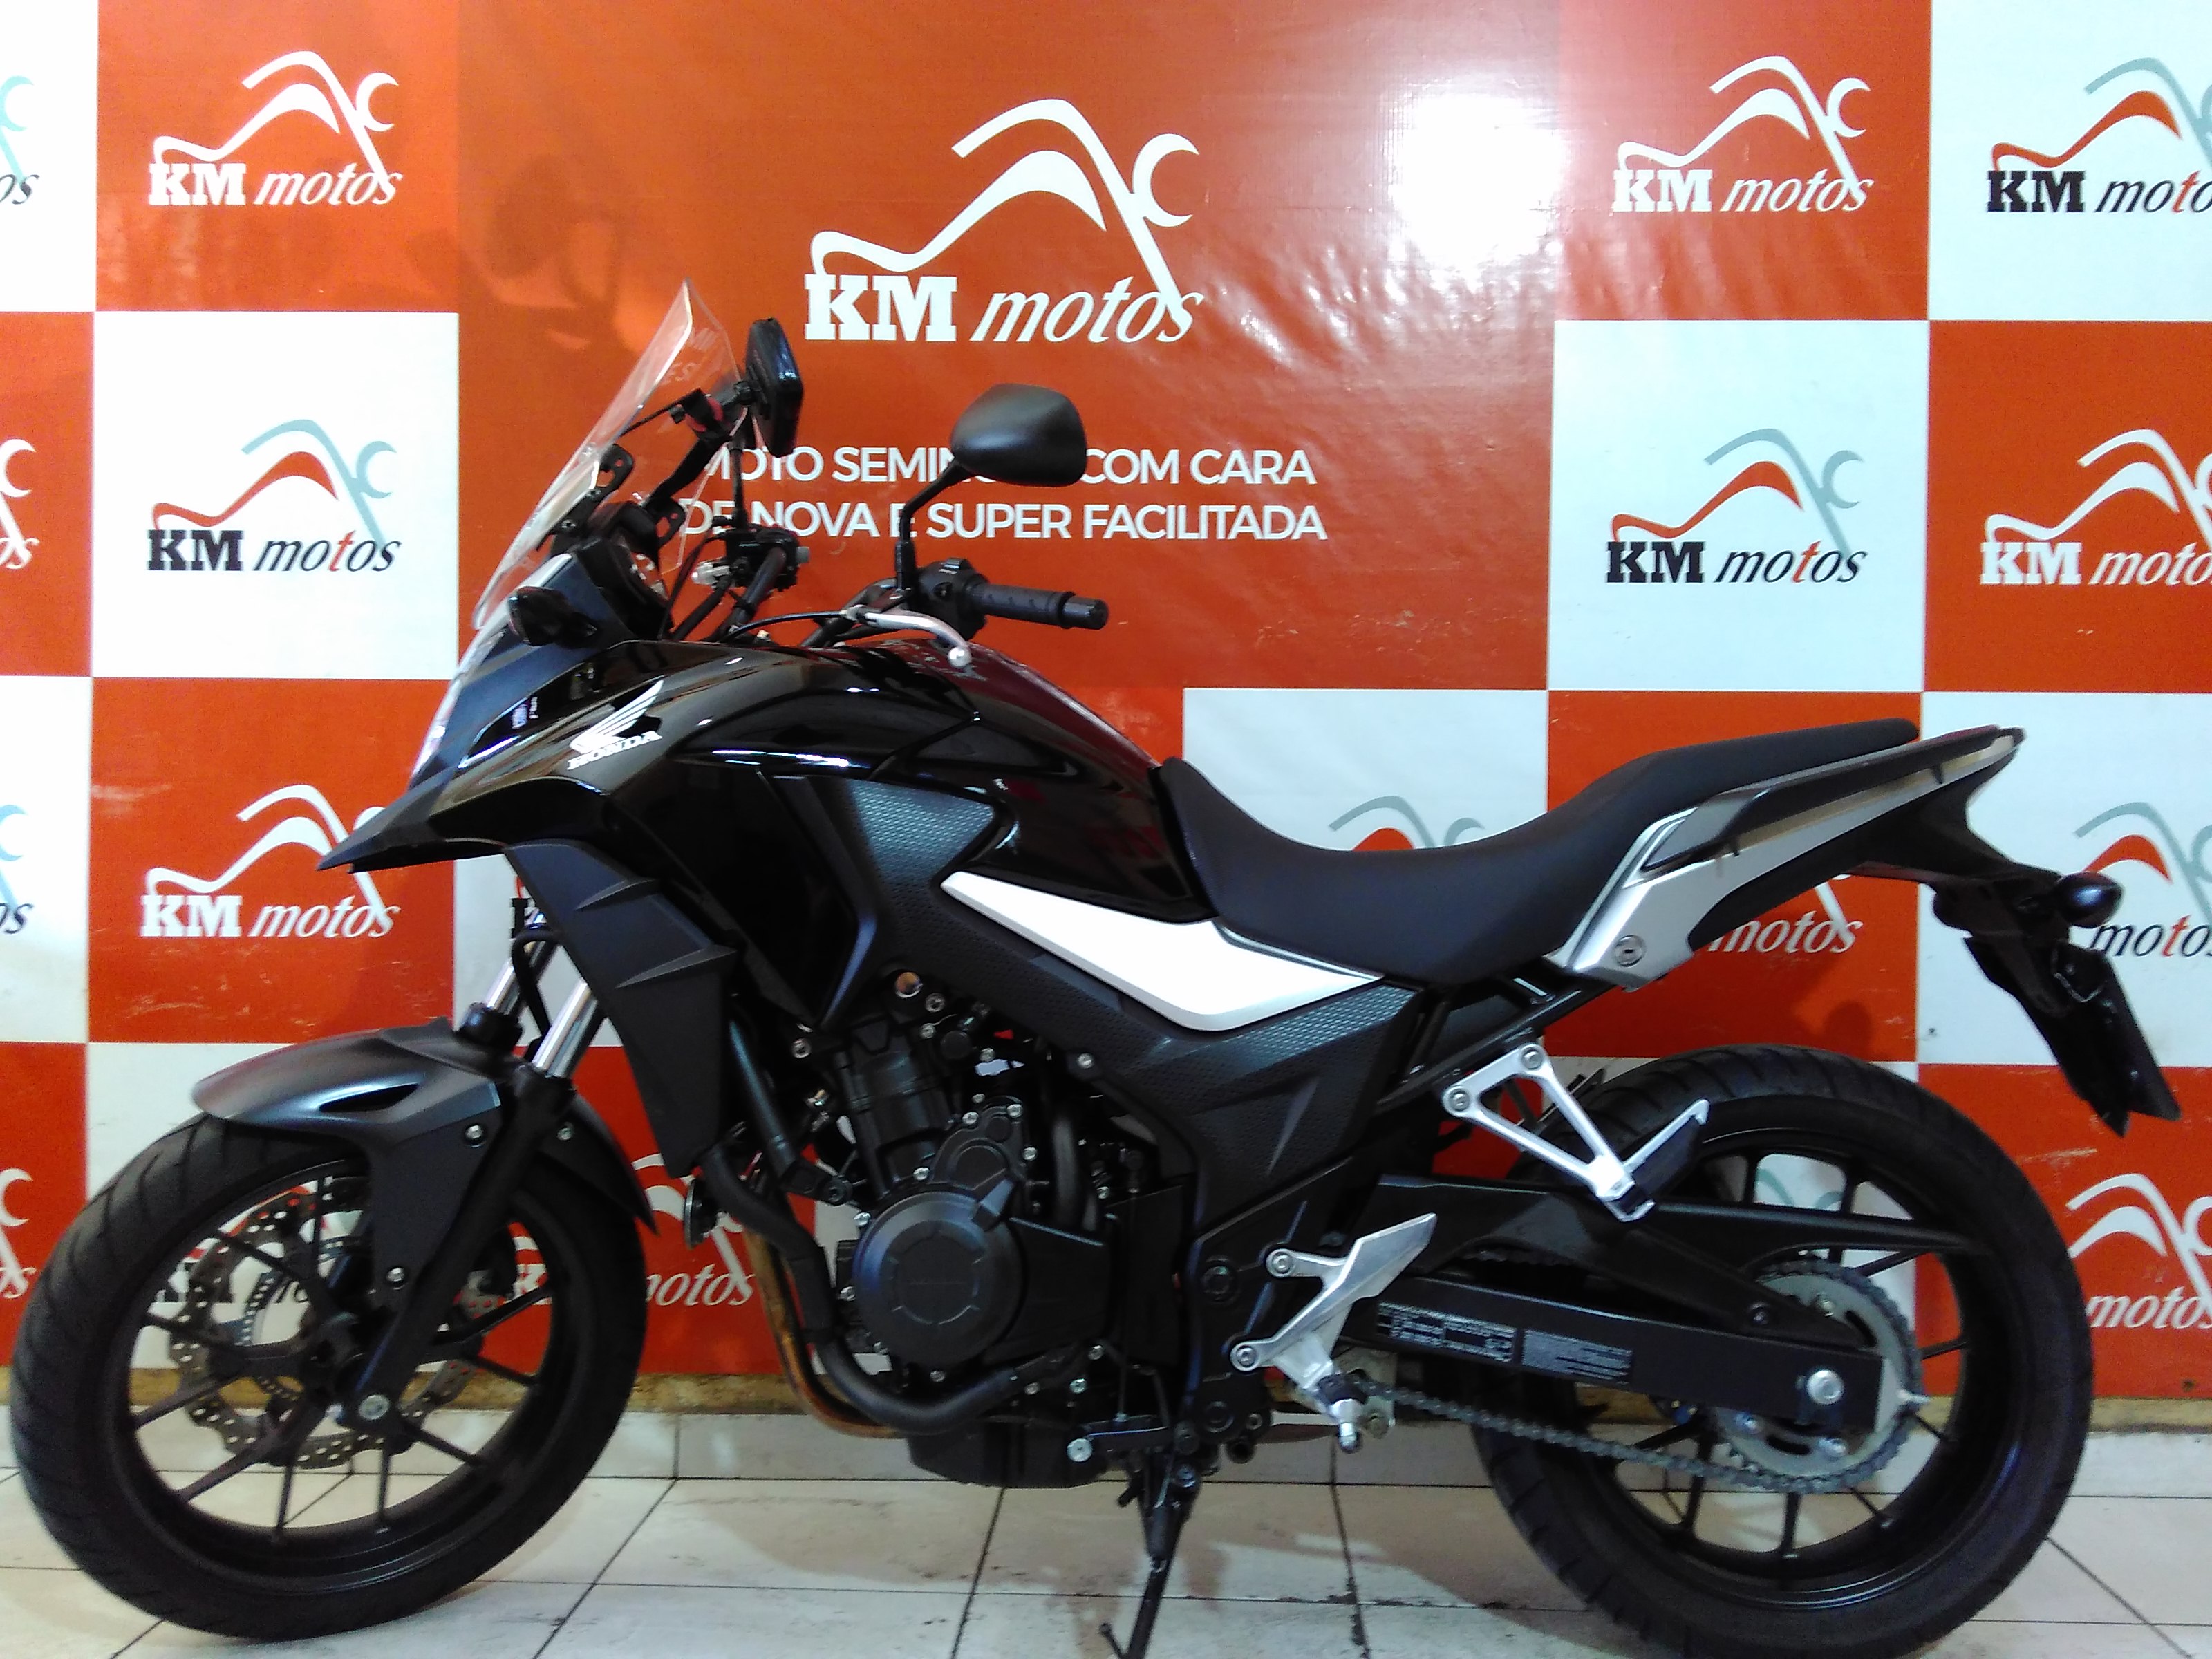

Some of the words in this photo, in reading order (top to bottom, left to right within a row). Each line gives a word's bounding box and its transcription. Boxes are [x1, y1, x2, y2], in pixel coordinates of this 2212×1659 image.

[149, 163, 246, 205] KM
[254, 164, 403, 205] motos
[1612, 169, 1712, 212] KM
[1720, 169, 1875, 212] motos
[1987, 170, 2084, 213] KM
[804, 274, 957, 341] KM
[970, 276, 1203, 343] motos
[1190, 449, 1317, 485] CARA
[751, 500, 881, 538] NOVA
[926, 503, 1071, 538] SUPER
[1084, 505, 1328, 540] FACILITADA
[147, 529, 243, 571] KM
[252, 531, 402, 572] motos
[1606, 541, 1705, 583] KM
[1714, 541, 1868, 583] motos
[1980, 542, 2083, 586] KM
[2088, 543, 2212, 587] moto
[567, 730, 663, 771] HONDA
[140, 895, 243, 937] KM
[247, 895, 401, 938] motos
[1707, 910, 1863, 954] motos
[2090, 915, 2212, 957] moto
